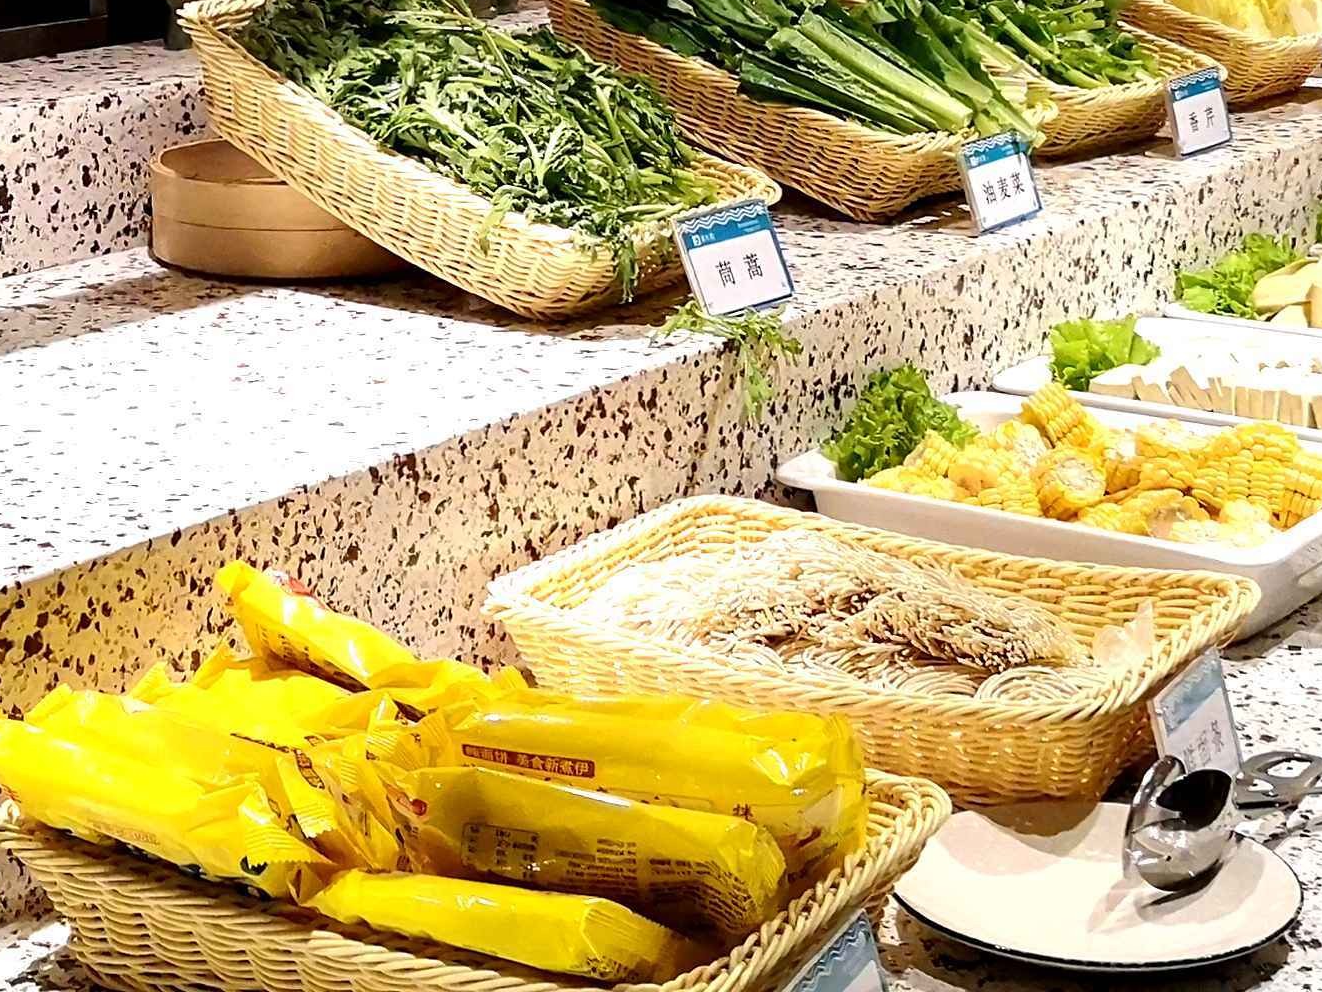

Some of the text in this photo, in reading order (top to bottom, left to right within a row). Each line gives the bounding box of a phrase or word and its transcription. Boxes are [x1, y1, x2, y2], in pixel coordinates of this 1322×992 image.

[982, 171, 1026, 205] 油麦菜
[715, 252, 764, 288] 茼蒿
